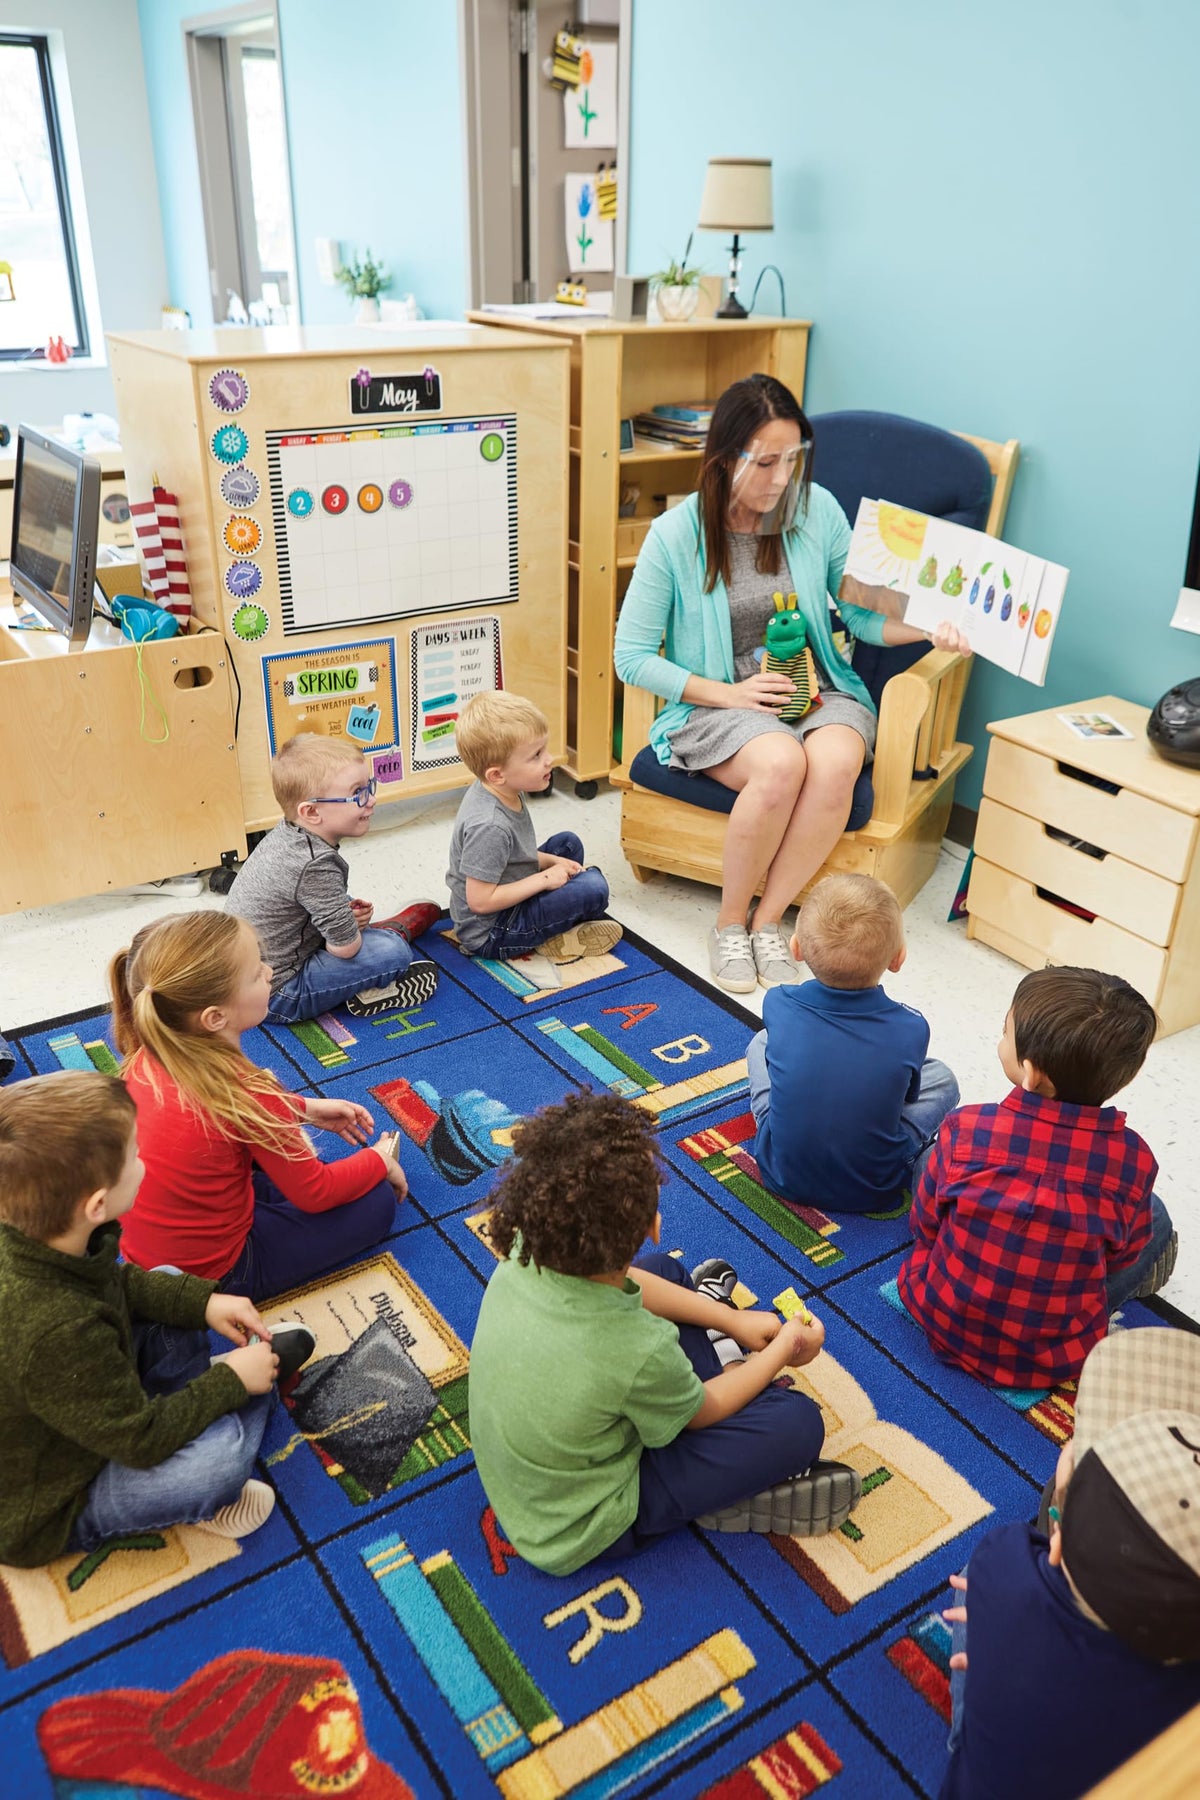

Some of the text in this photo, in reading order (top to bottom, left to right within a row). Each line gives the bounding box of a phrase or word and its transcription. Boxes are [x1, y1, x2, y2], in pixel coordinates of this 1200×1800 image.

[379, 382, 419, 412] May
[489, 442, 494, 454] 1
[296, 488, 404, 510] 2 3 4 5
[425, 631, 450, 646] DAYS
[460, 626, 486, 641] WEEK
[305, 653, 360, 669] THE SEASON IS
[299, 669, 357, 694] SPRING
[305, 696, 366, 713] THE WEATHER IS
[329, 724, 342, 732] AND
[352, 717, 374, 731] COOL
[378, 761, 400, 775] COLD
[372, 1007, 438, 1040] H
[601, 1002, 660, 1031] A
[651, 1033, 712, 1064] B
[368, 1290, 418, 1350] Diploma
[542, 1575, 644, 1666] R
